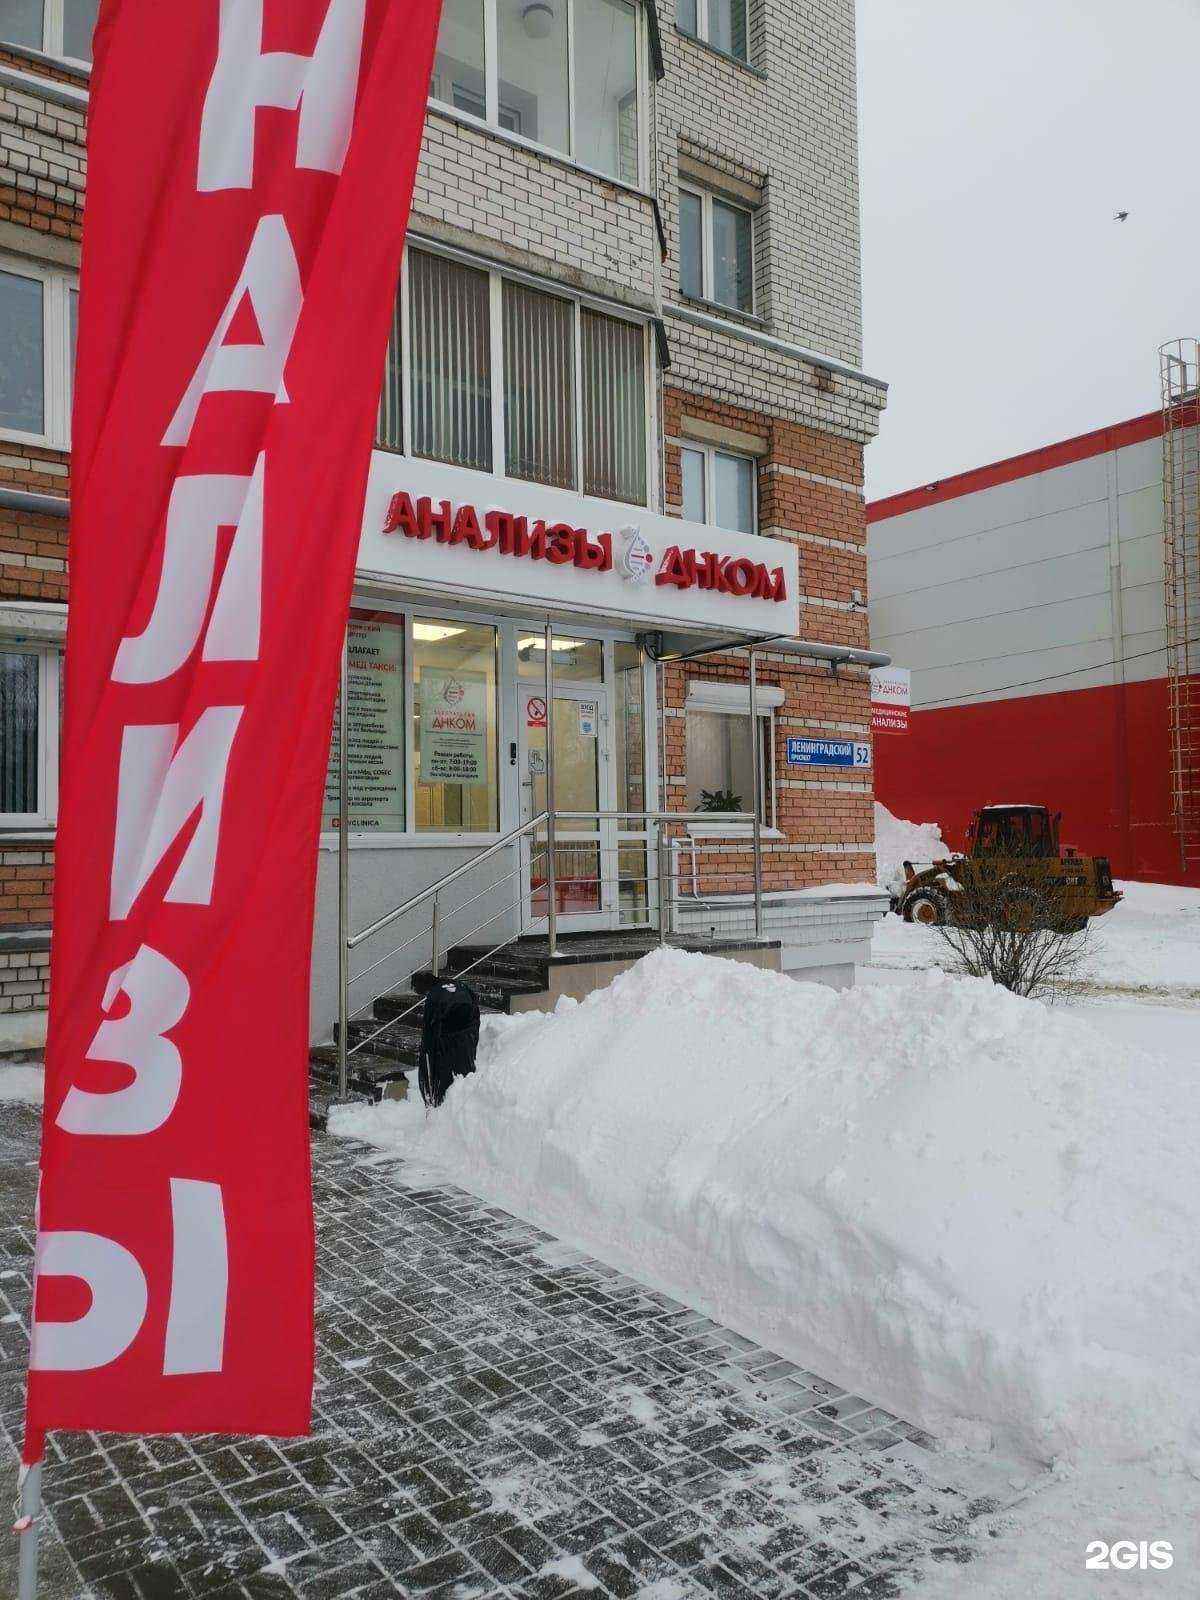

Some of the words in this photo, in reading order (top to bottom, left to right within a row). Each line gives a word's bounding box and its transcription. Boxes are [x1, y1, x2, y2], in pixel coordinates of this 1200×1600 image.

[382, 490, 613, 571] АНАЛИЗЫ
[655, 545, 787, 602] ДНКОМ
[883, 683, 909, 695] ДНКОМ
[432, 718, 476, 730] ДНКОМ
[871, 717, 908, 729] АНАЛИЗЫ
[791, 742, 852, 757] ЛЕНИНГРАДСКИЙ
[856, 747, 869, 764] 52
